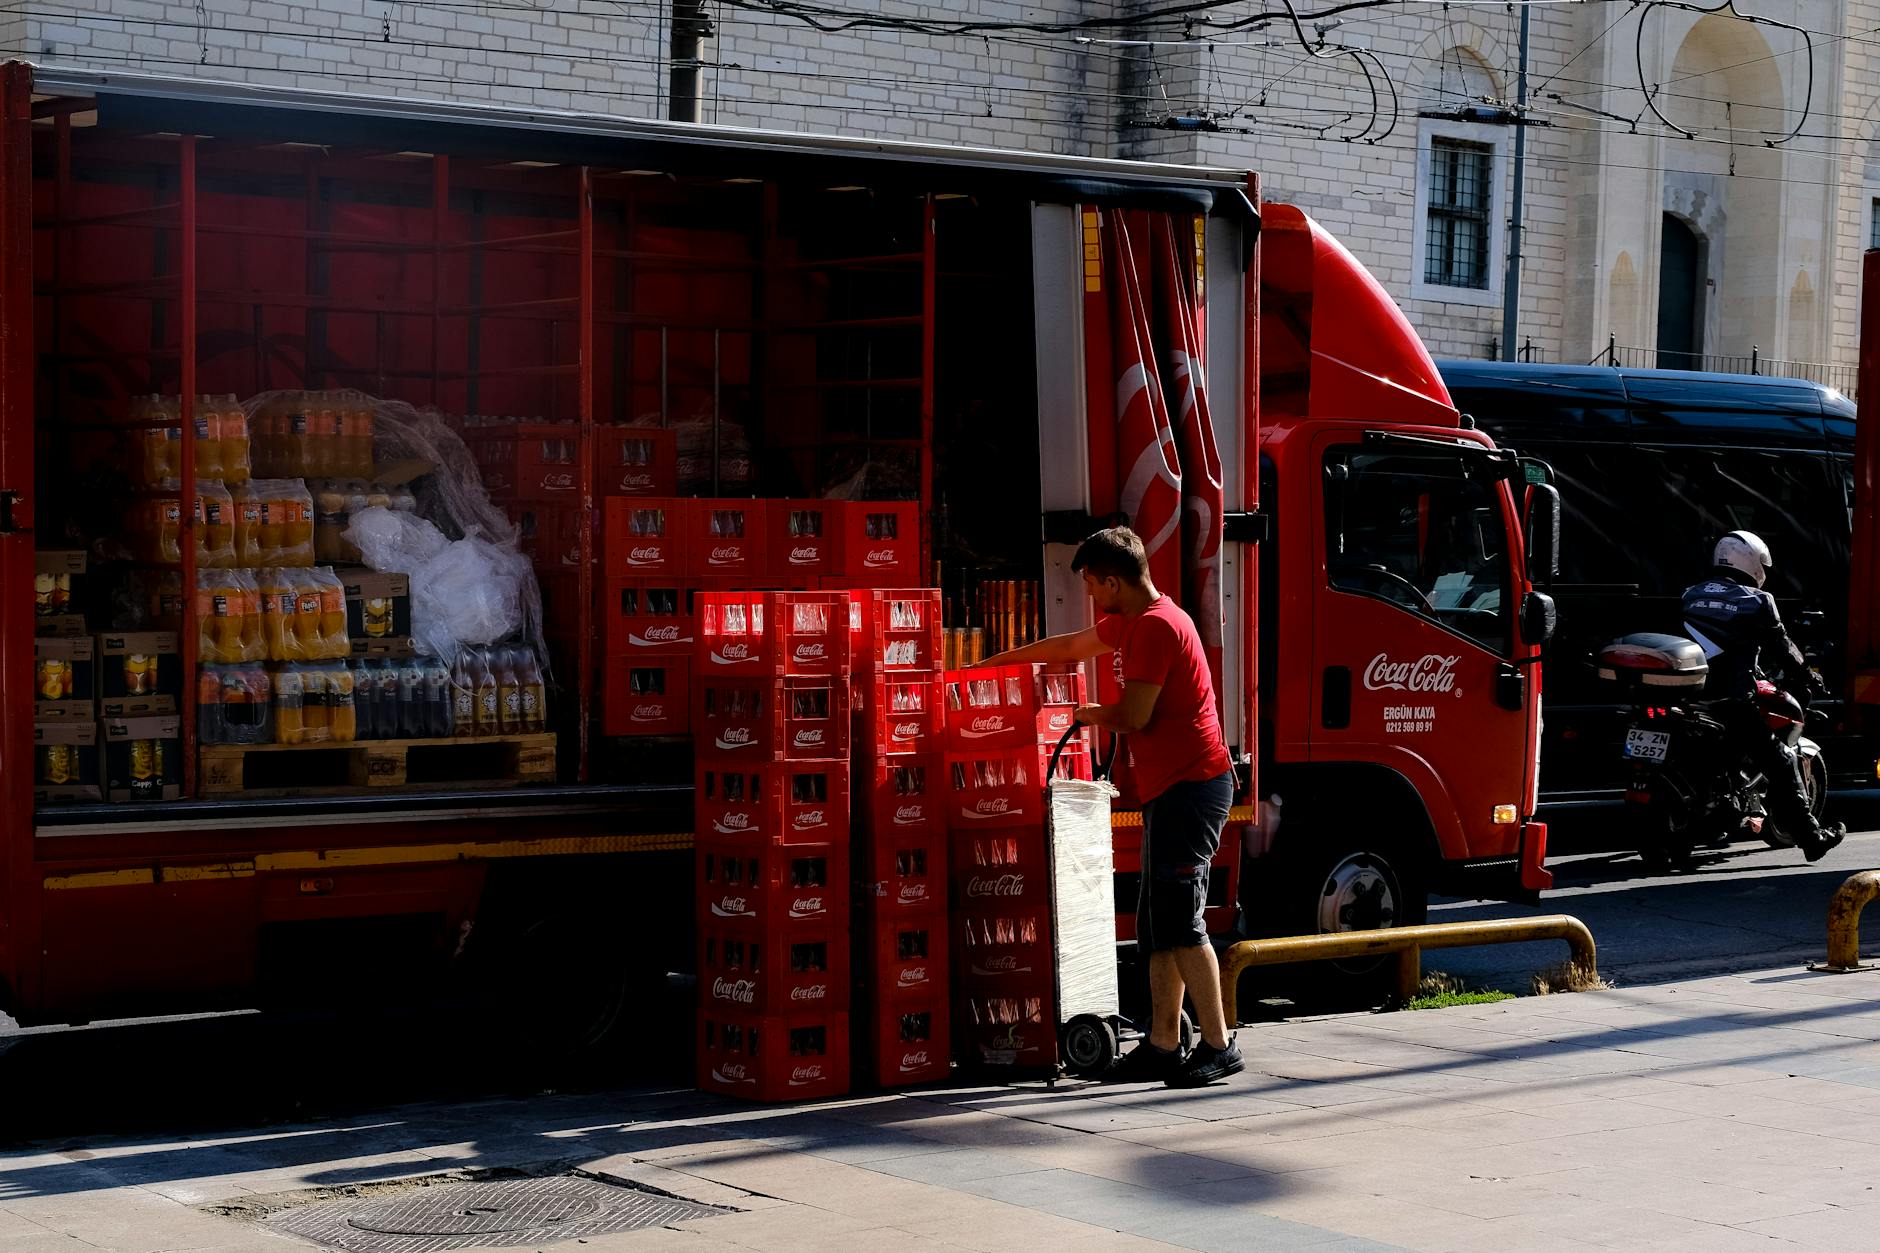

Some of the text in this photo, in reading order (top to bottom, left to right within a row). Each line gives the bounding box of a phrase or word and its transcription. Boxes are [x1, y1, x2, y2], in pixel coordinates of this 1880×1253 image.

[1363, 653, 1462, 692] Coca-Cola
[1383, 704, 1436, 720] ERGÜN KAYA
[1385, 722, 1402, 733] 0212
[1425, 722, 1433, 732] 91
[1629, 731, 1668, 745] 34 ZN
[1634, 745, 1665, 757] 5257
[966, 874, 1025, 897] Coca-Cola
[712, 976, 756, 1004] Coca-Cola
[790, 985, 826, 1000] Coca-Cola
